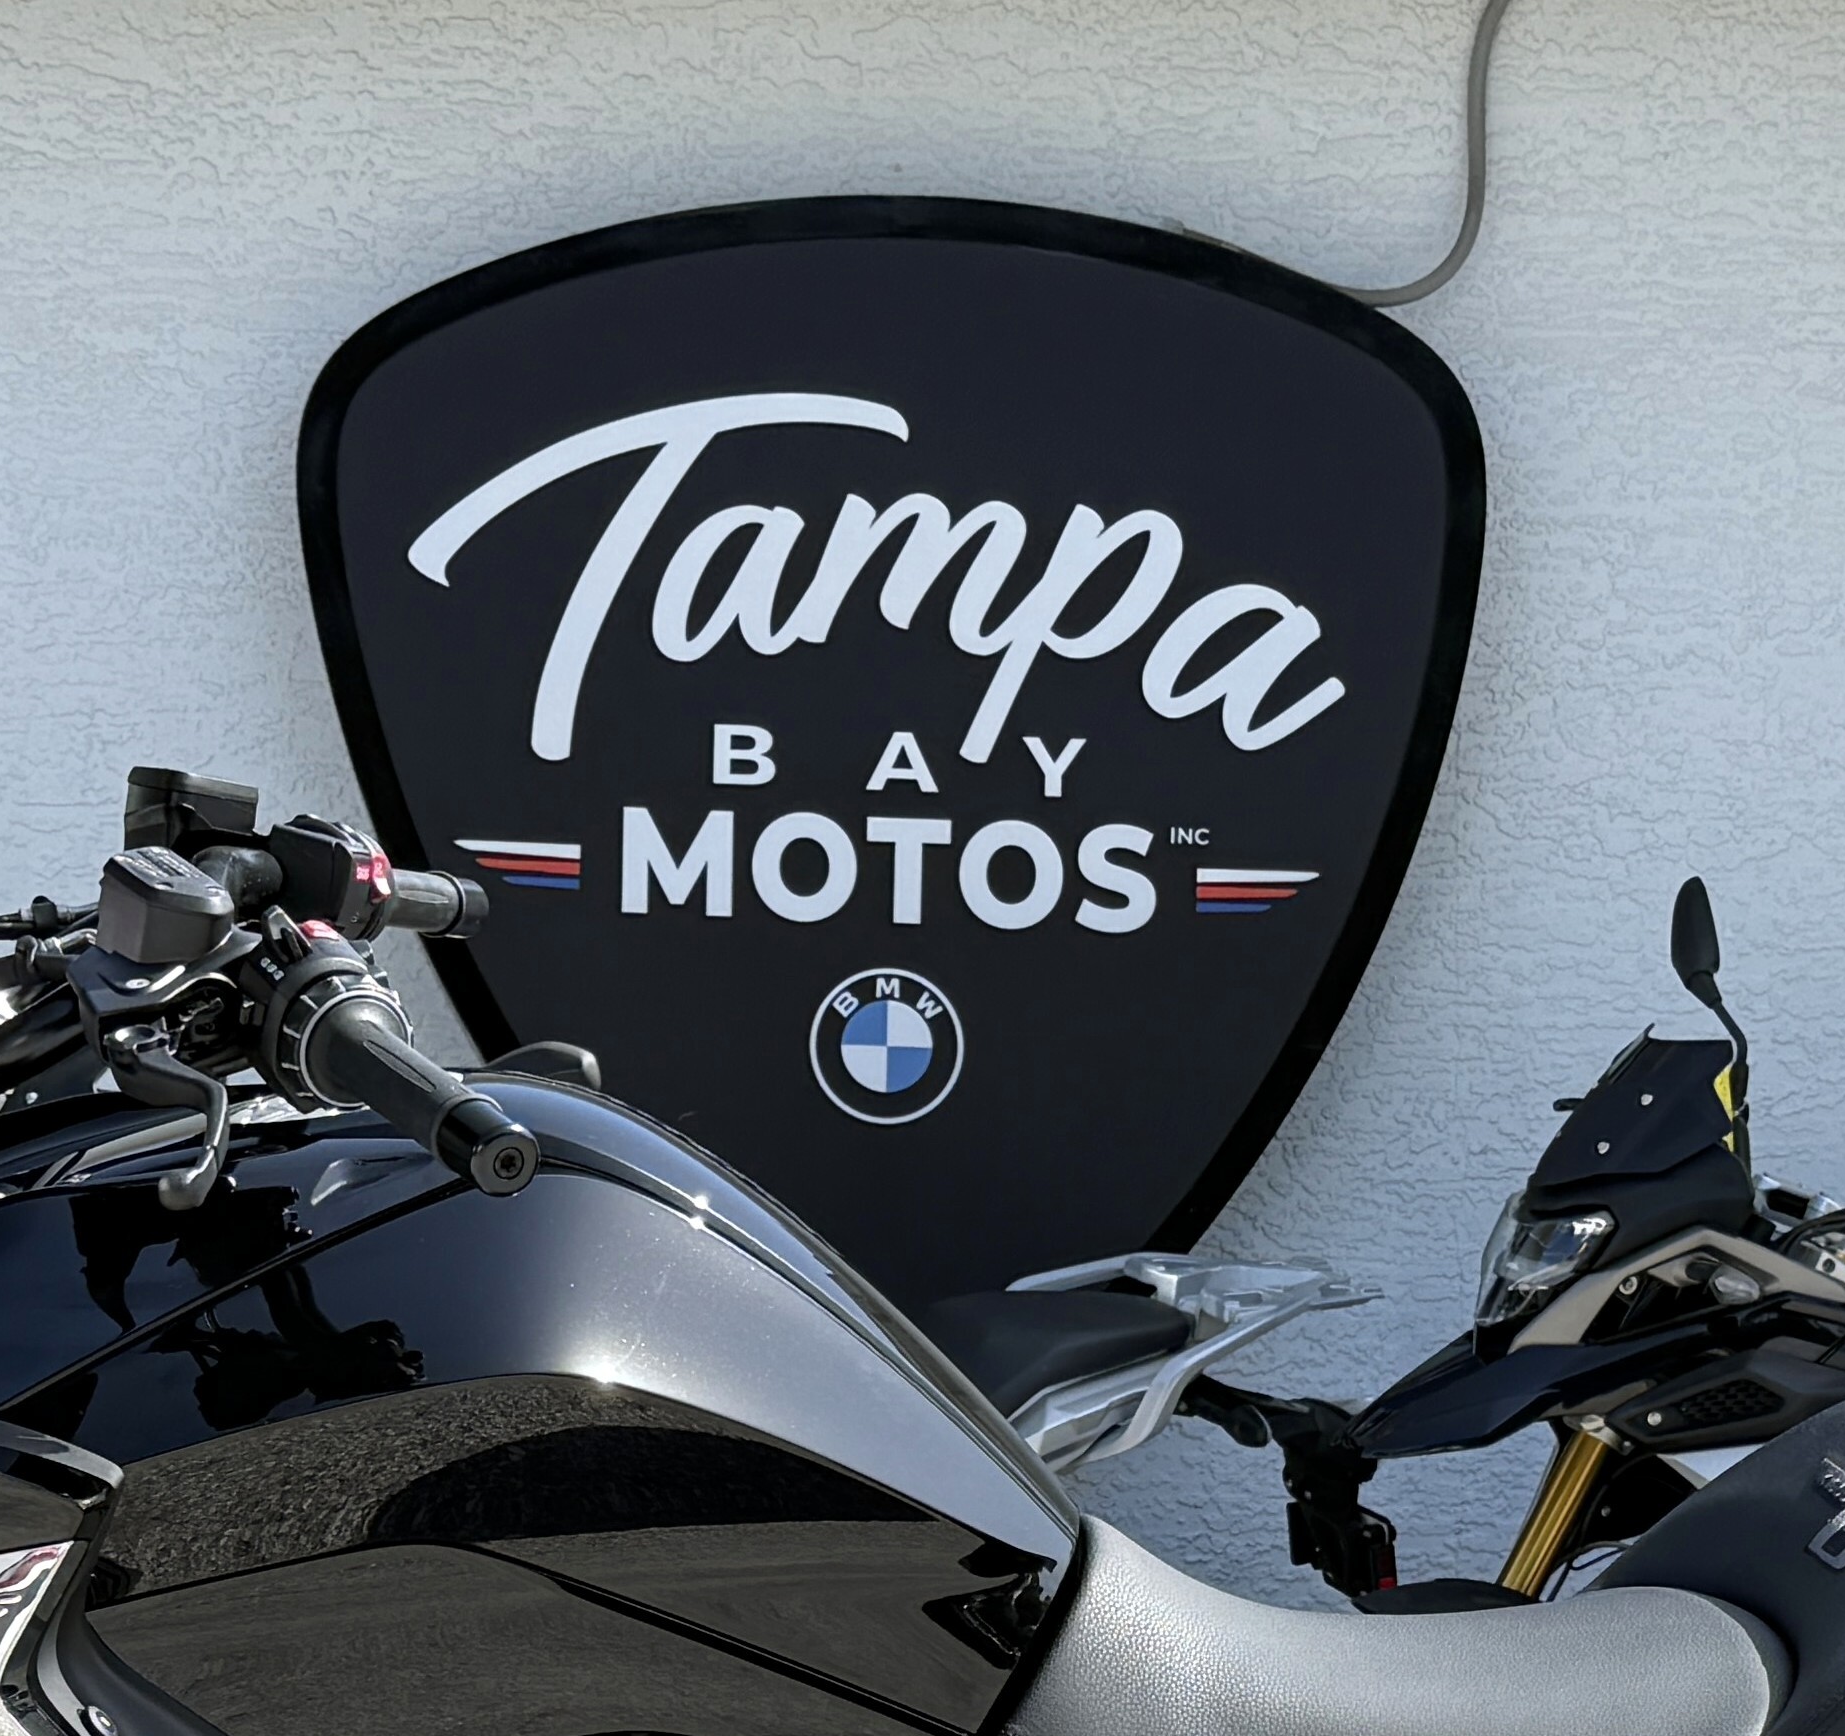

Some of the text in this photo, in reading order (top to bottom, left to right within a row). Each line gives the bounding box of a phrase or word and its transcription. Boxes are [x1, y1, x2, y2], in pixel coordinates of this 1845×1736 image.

[407, 391, 1346, 763] Tampa
[711, 723, 1086, 798] BAY
[620, 807, 1156, 933] MOTOS
[1169, 827, 1210, 846] INC
[831, 976, 945, 1021] BMW
